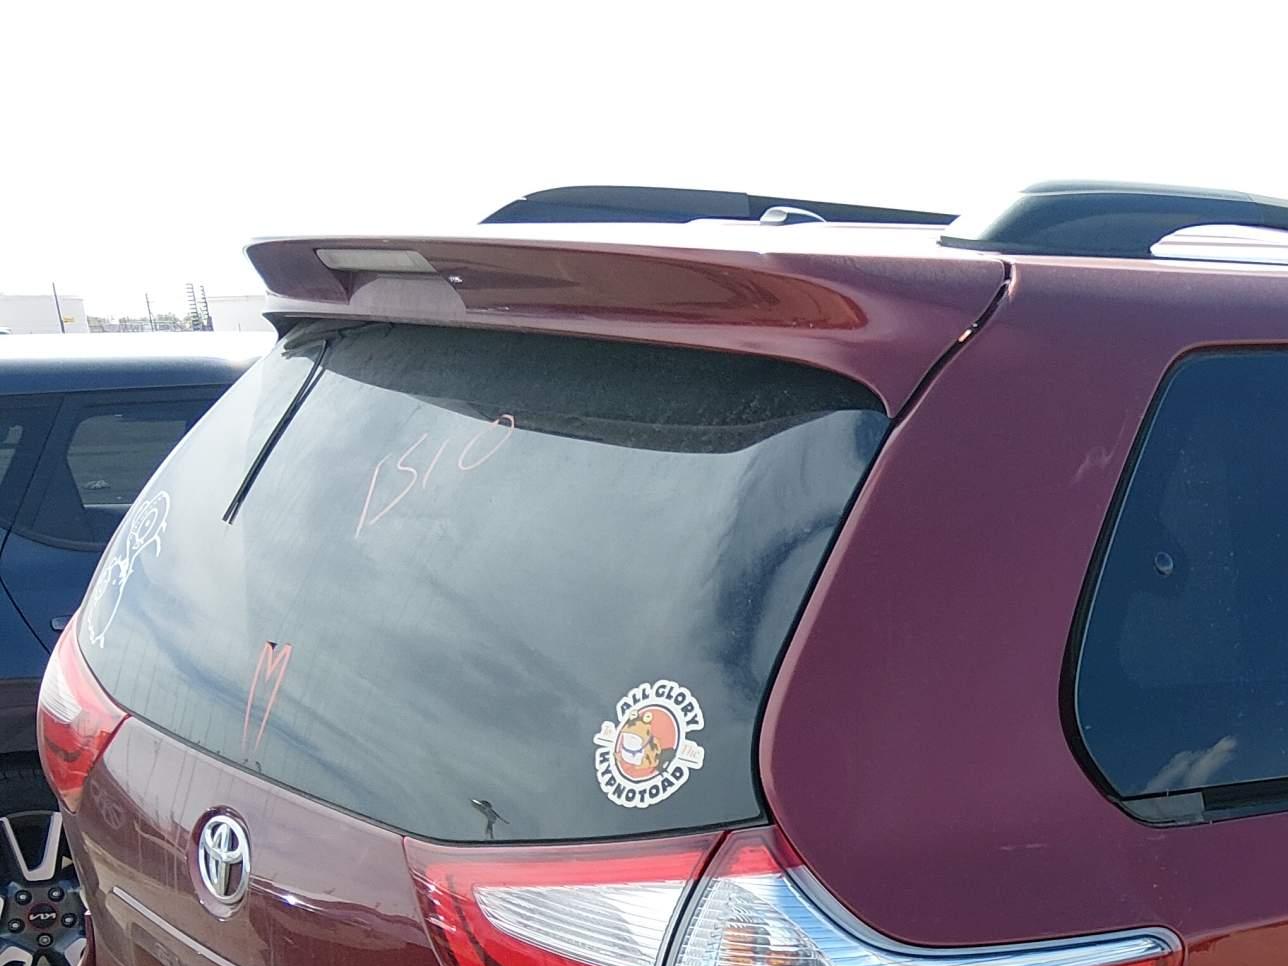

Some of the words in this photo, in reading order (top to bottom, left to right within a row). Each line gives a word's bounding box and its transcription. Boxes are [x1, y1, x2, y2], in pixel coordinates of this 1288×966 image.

[620, 688, 650, 716] ALL
[655, 685, 700, 726] GLORY
[599, 751, 685, 803] HYPNOTOAD
